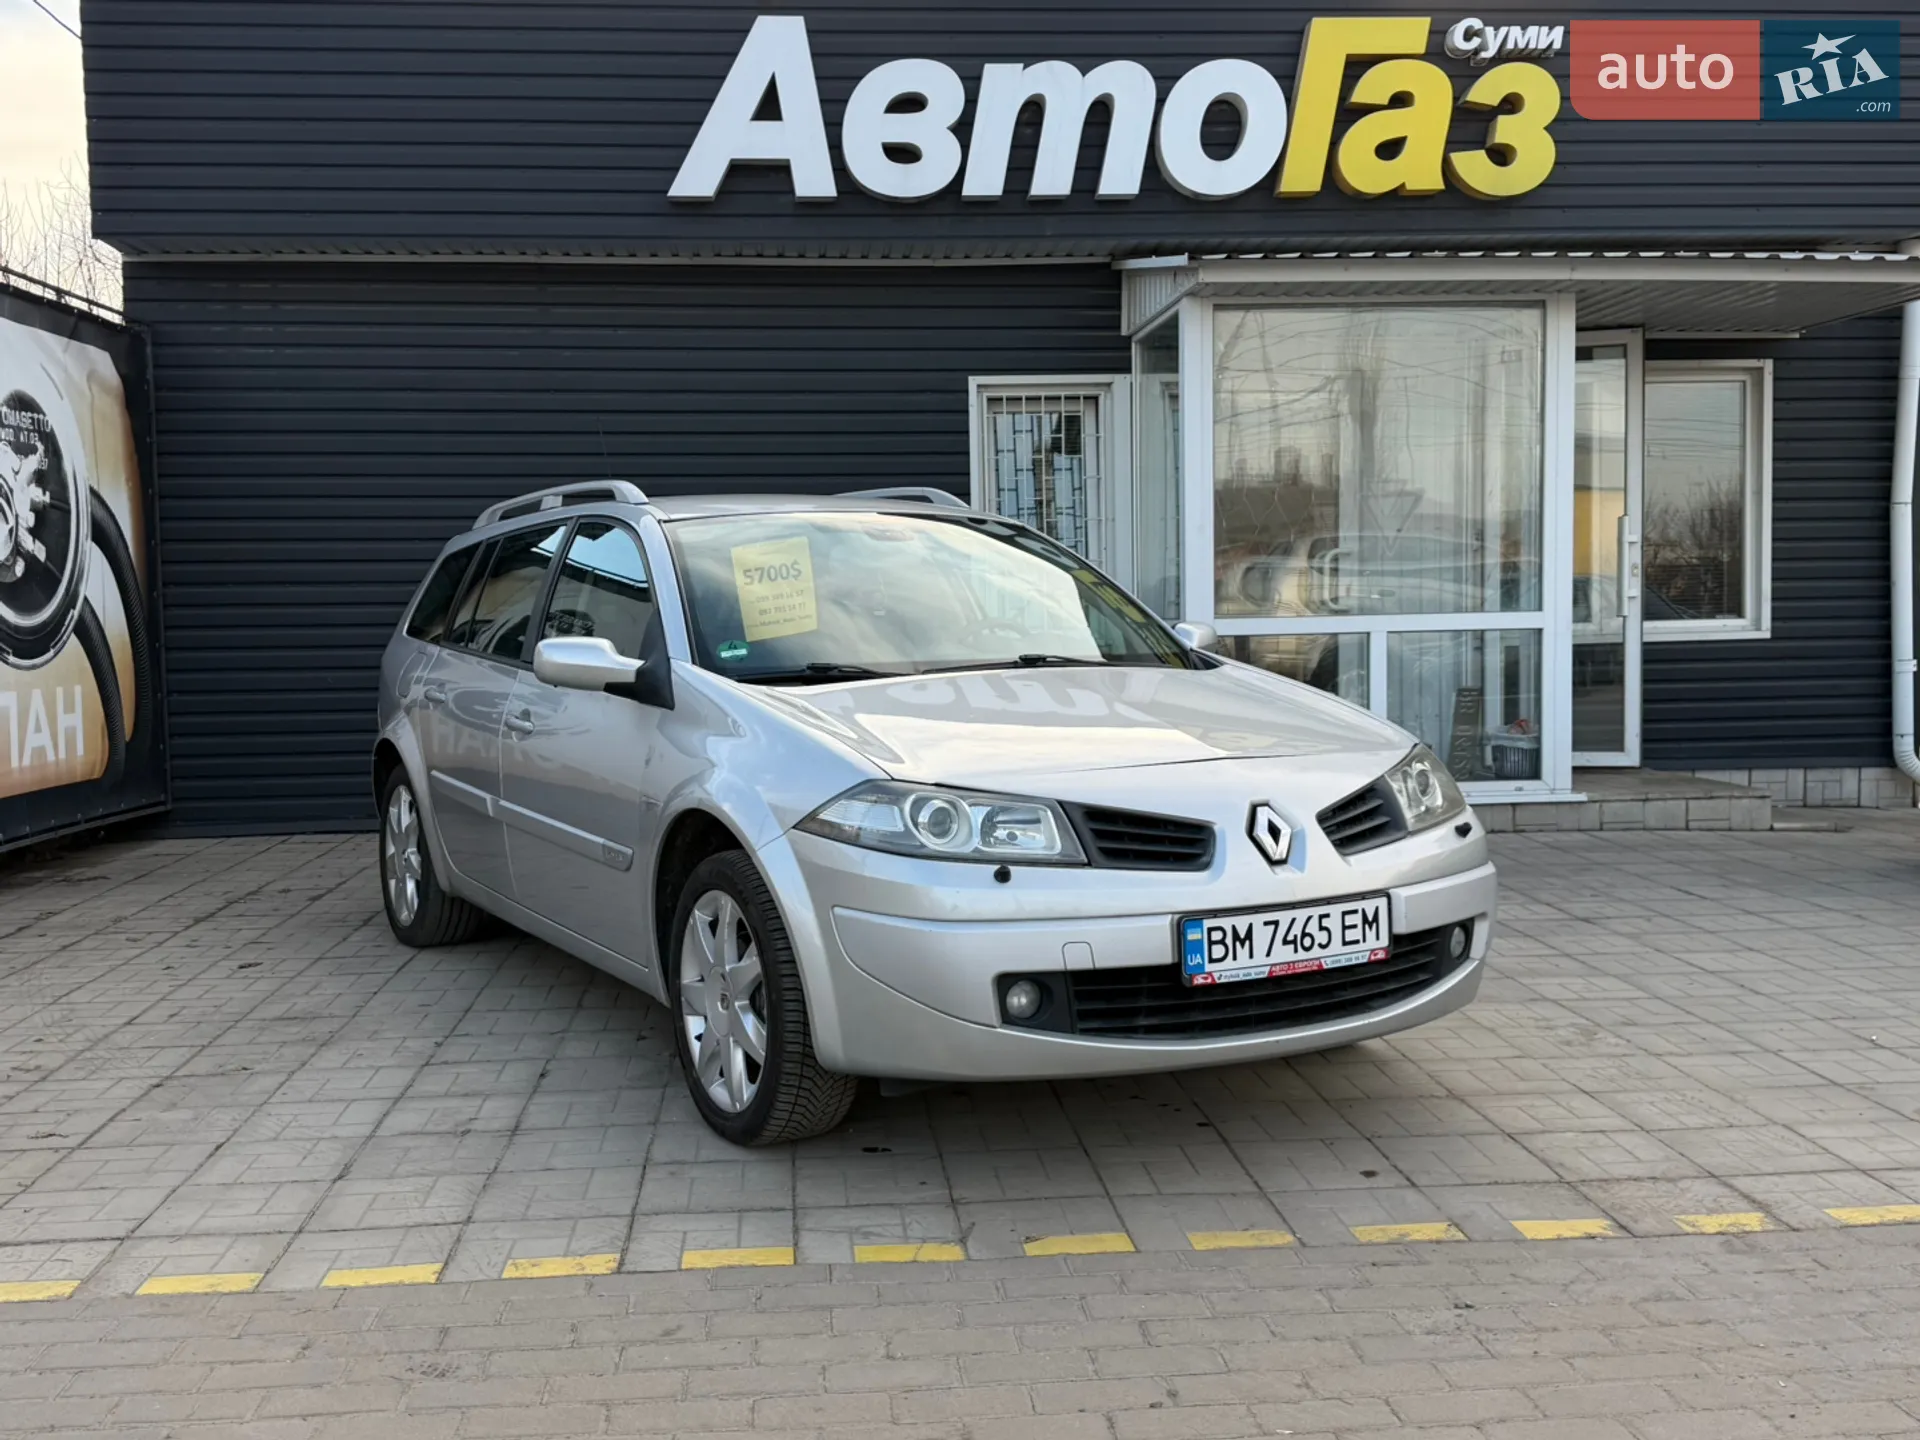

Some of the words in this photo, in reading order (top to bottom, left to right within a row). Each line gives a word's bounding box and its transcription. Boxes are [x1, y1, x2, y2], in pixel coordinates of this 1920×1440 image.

[1450, 17, 1565, 61] Суми
[666, 15, 1561, 200] АвтоГаз
[742, 559, 802, 586] 5700$
[1187, 952, 1203, 966] UA
[1206, 922, 1254, 964] BM
[1263, 912, 1332, 958] 7465
[1341, 905, 1380, 947] EM
